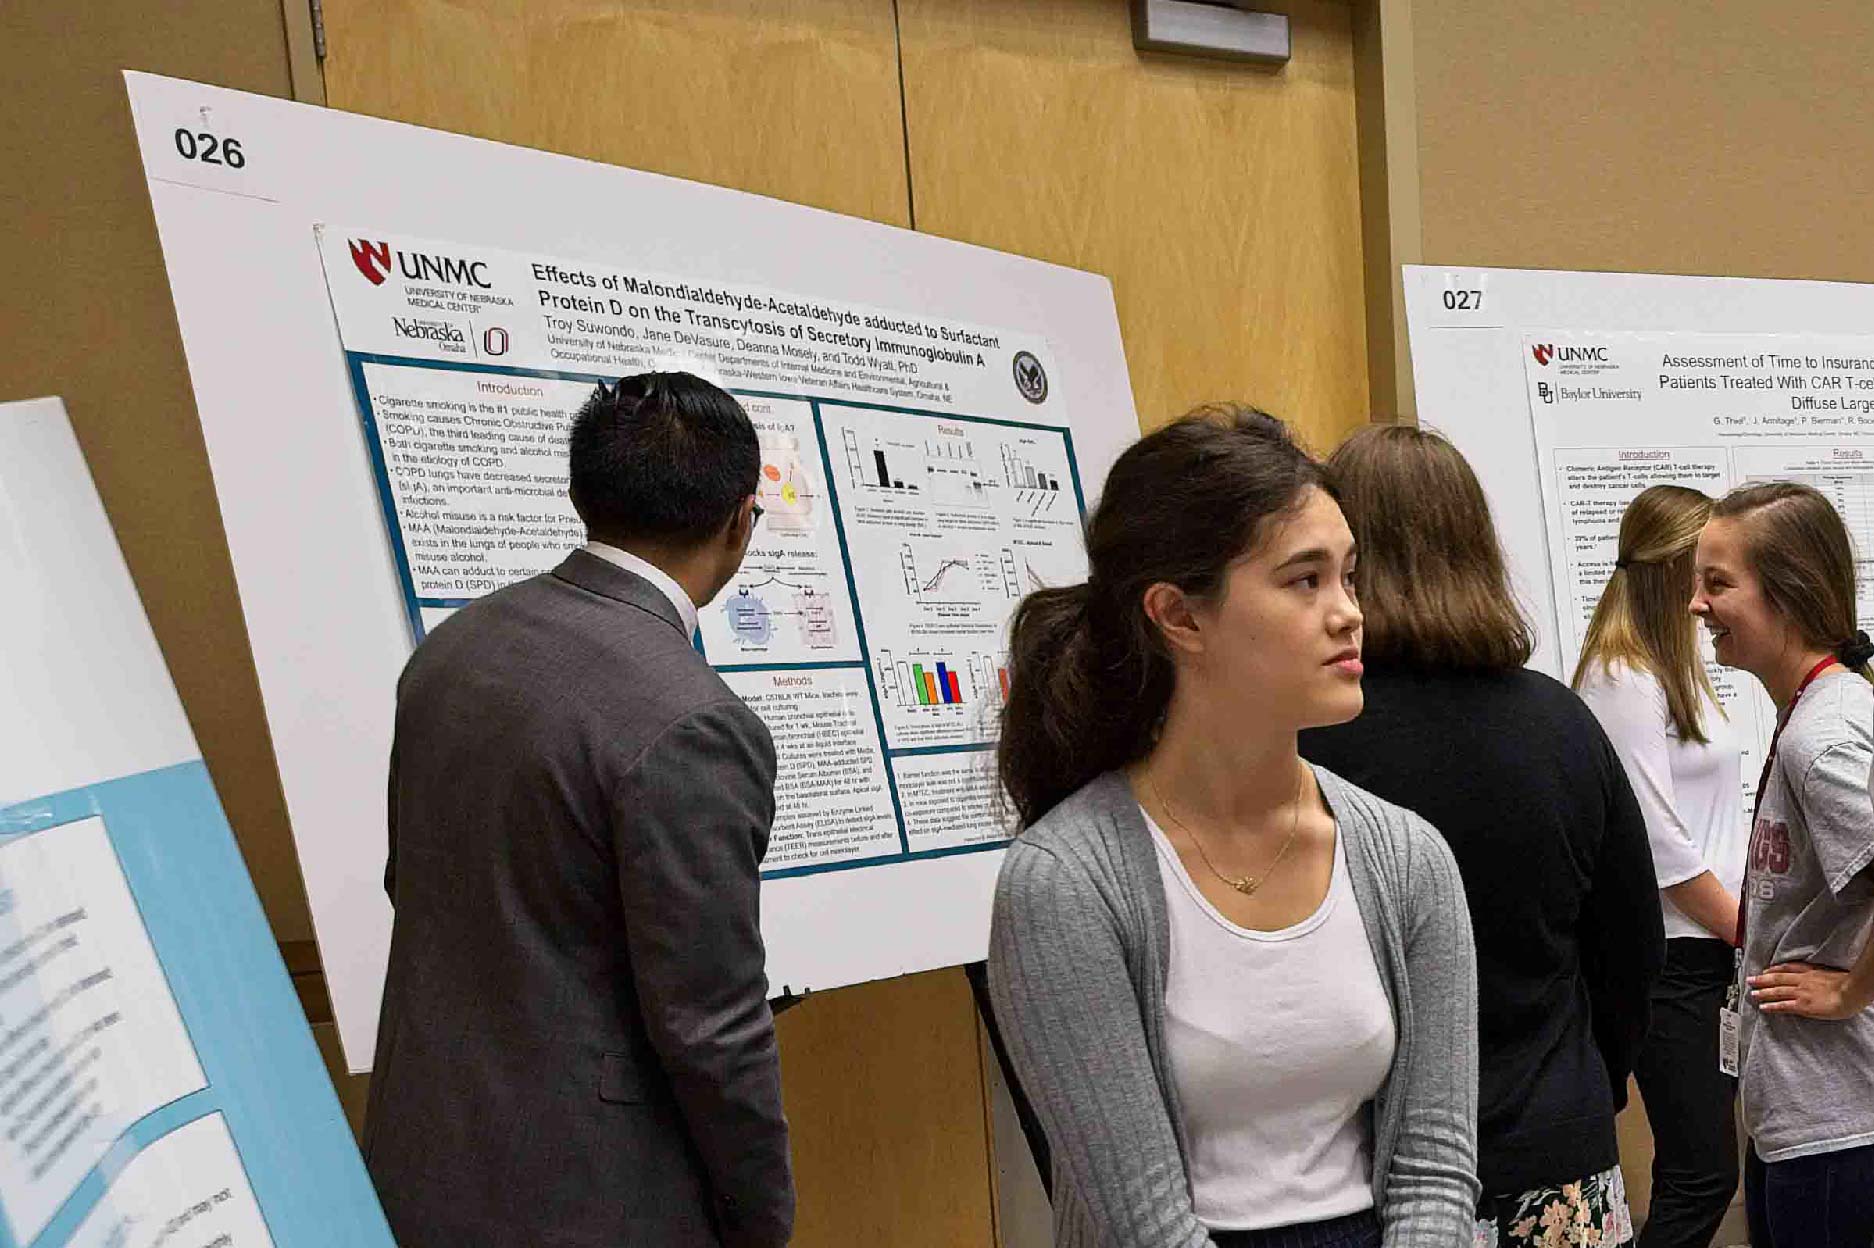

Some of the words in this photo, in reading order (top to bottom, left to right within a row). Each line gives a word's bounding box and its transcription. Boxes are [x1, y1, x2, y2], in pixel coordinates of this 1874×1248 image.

[174, 127, 246, 169] 026
[397, 251, 492, 288] UNMC
[405, 286, 454, 298] UNIVERSITY
[457, 292, 468, 301] OF
[1443, 288, 1483, 311] 027
[407, 297, 444, 310] MEDICAL
[532, 263, 596, 288] Effects
[602, 276, 618, 291] of
[623, 277, 860, 326] Malondialdehyde-Acetaldehyde
[864, 316, 922, 336] adducted
[925, 324, 937, 339] to
[941, 326, 1000, 349] Surfactant
[392, 317, 464, 342] Nebraska
[538, 290, 605, 315] Protein
[610, 300, 622, 315] D
[629, 305, 650, 319] on
[655, 306, 681, 323] the
[685, 309, 785, 337] Transcytosis
[790, 324, 803, 340] of
[808, 327, 871, 351] Secretory
[875, 337, 973, 366] Immunoglobulin
[976, 353, 985, 367] A
[544, 315, 572, 332] Troy
[643, 326, 671, 342] Jane
[737, 338, 779, 355] Deanna
[823, 351, 840, 364] and
[842, 353, 865, 367] Todd
[548, 334, 596, 351] University
[598, 340, 606, 349] of
[608, 341, 650, 354] Nebraska
[718, 352, 771, 368] Departments
[773, 358, 781, 368] of
[551, 348, 611, 365] Occupational
[1558, 347, 1609, 361] UNMC
[1662, 354, 1746, 368] Assessment
[1751, 355, 1764, 368] of
[1769, 355, 1801, 368] Time
[1806, 356, 1817, 369] to
[477, 381, 543, 397] Introduction
[1659, 375, 1717, 389] Patients
[1721, 375, 1773, 389] Treated
[1777, 376, 1807, 389] With
[1811, 376, 1841, 390] CAR
[1561, 388, 1591, 402] Baylor
[1593, 388, 1642, 402] University
[379, 395, 424, 408] Cigarette
[427, 401, 466, 414] smoking
[469, 402, 477, 412] is
[479, 402, 495, 413] the
[512, 407, 538, 417] public
[540, 409, 568, 419] health
[1791, 397, 1837, 410] Diffuse
[383, 411, 424, 424] Smoking
[427, 415, 461, 425] causes
[464, 416, 501, 428] Chronic
[503, 418, 554, 431] Obstructive
[430, 427, 445, 438] the
[448, 428, 469, 439] third
[471, 429, 505, 443] leading
[509, 432, 534, 443] cause
[537, 433, 545, 443] of
[938, 424, 964, 437] Results
[414, 440, 454, 453] cigarette
[458, 444, 499, 456] smoking
[501, 445, 517, 455] and
[520, 445, 551, 456] alcohol
[1618, 451, 1670, 459] Introduction
[403, 454, 418, 463] the
[461, 456, 470, 466] of
[428, 468, 454, 481] lungs
[457, 471, 480, 481] have
[483, 471, 531, 483] decreased
[448, 485, 492, 496] important
[495, 486, 554, 498] anti-microbial
[406, 509, 440, 520] Alcohol
[443, 511, 477, 521] misuse
[516, 513, 542, 523] factor
[544, 514, 555, 523] for
[452, 539, 467, 549] the
[470, 539, 495, 551] lungs
[509, 541, 539, 551] people
[415, 552, 447, 561] misuse
[442, 568, 459, 576] can
[463, 567, 494, 576] adduct
[421, 580, 453, 591] protein
[455, 580, 463, 589] D
[773, 676, 813, 687] Methods
